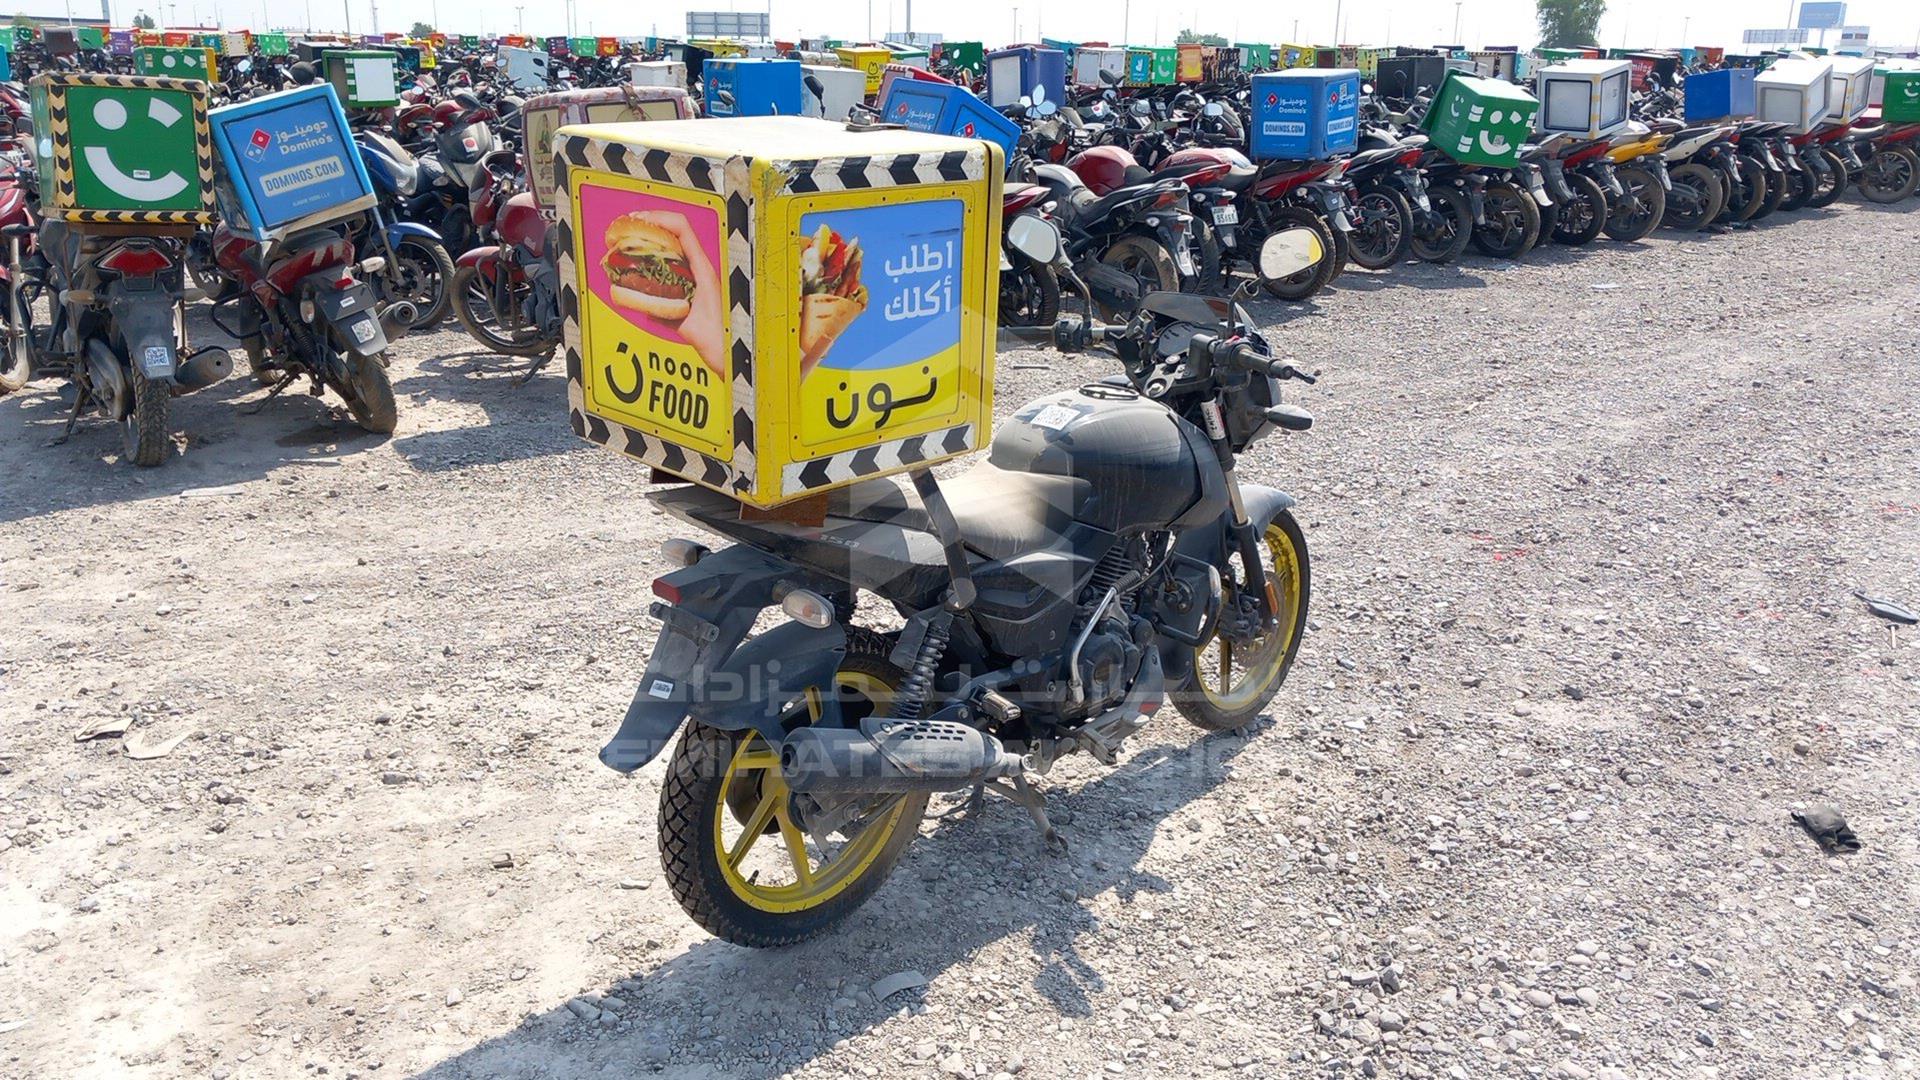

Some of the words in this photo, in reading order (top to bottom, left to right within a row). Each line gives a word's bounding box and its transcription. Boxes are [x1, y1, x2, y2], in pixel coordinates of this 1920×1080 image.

[275, 121, 328, 144] دومينوز
[279, 134, 334, 155] Domino's
[264, 161, 340, 192] DOMINOS.COM
[884, 240, 953, 283] اطلب
[884, 275, 952, 321] أكلك
[648, 351, 709, 387] noon
[648, 380, 709, 429] FOOD
[826, 366, 937, 429] نون
